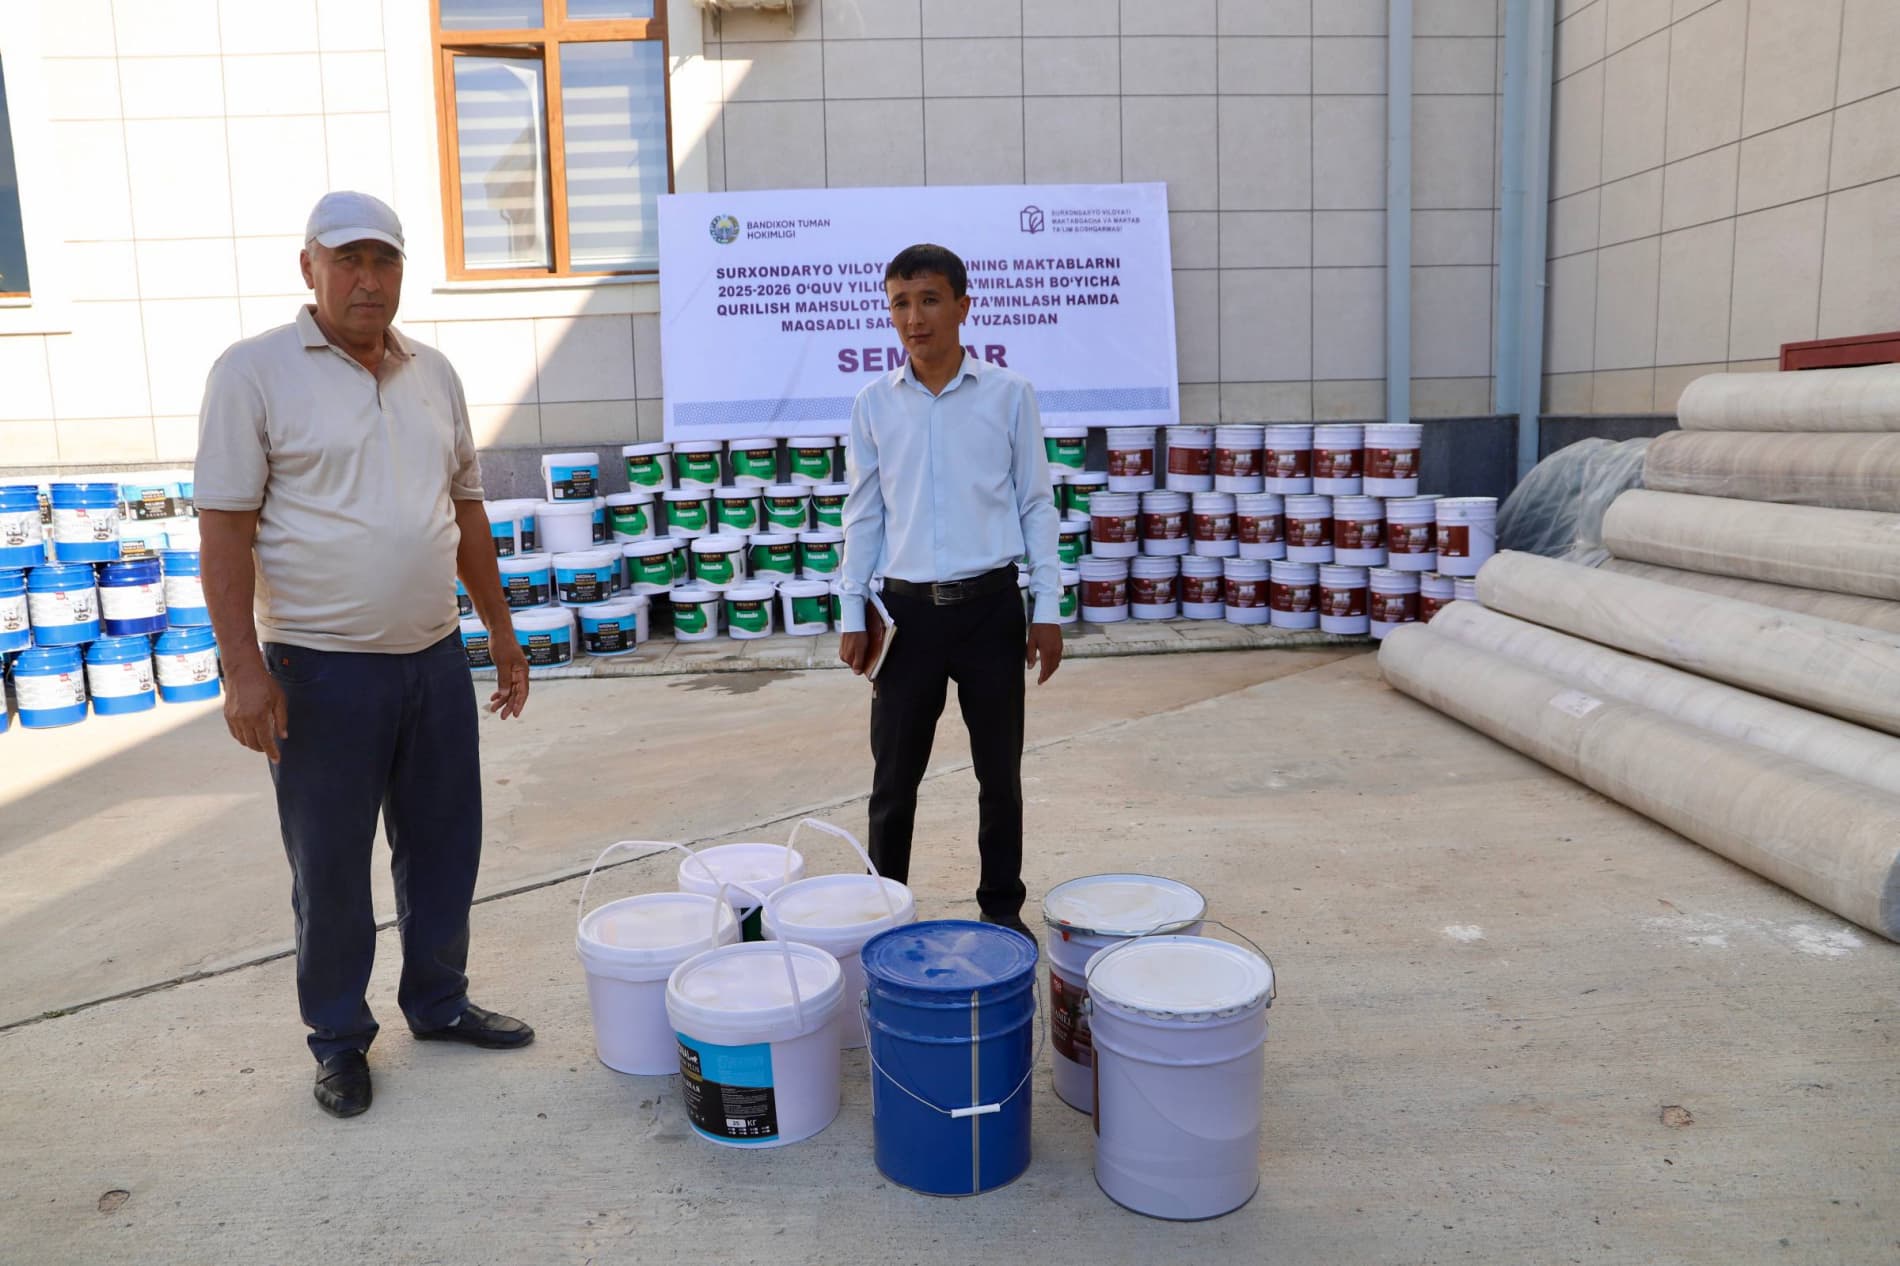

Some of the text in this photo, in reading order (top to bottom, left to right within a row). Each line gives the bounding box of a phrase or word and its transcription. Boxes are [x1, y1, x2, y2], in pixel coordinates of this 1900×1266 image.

[747, 219, 831, 230] BANDIXON TUMAN
[747, 230, 796, 239] HOKIMLIGI
[716, 264, 833, 280] SURXONDARYO
[838, 263, 884, 275] VILOY
[1013, 257, 1121, 271] MAKTABLARNI
[718, 283, 791, 298] 2025-2026
[965, 277, 1045, 290] A’MIRLASH
[1049, 275, 1121, 288] BO‘YICHA
[717, 302, 791, 316] QURILISH
[795, 299, 891, 313] MAHSULOTL
[1065, 294, 1120, 306] HAMDA
[781, 318, 861, 332] MAQSADLI
[971, 313, 1058, 326] YUZASIDAN
